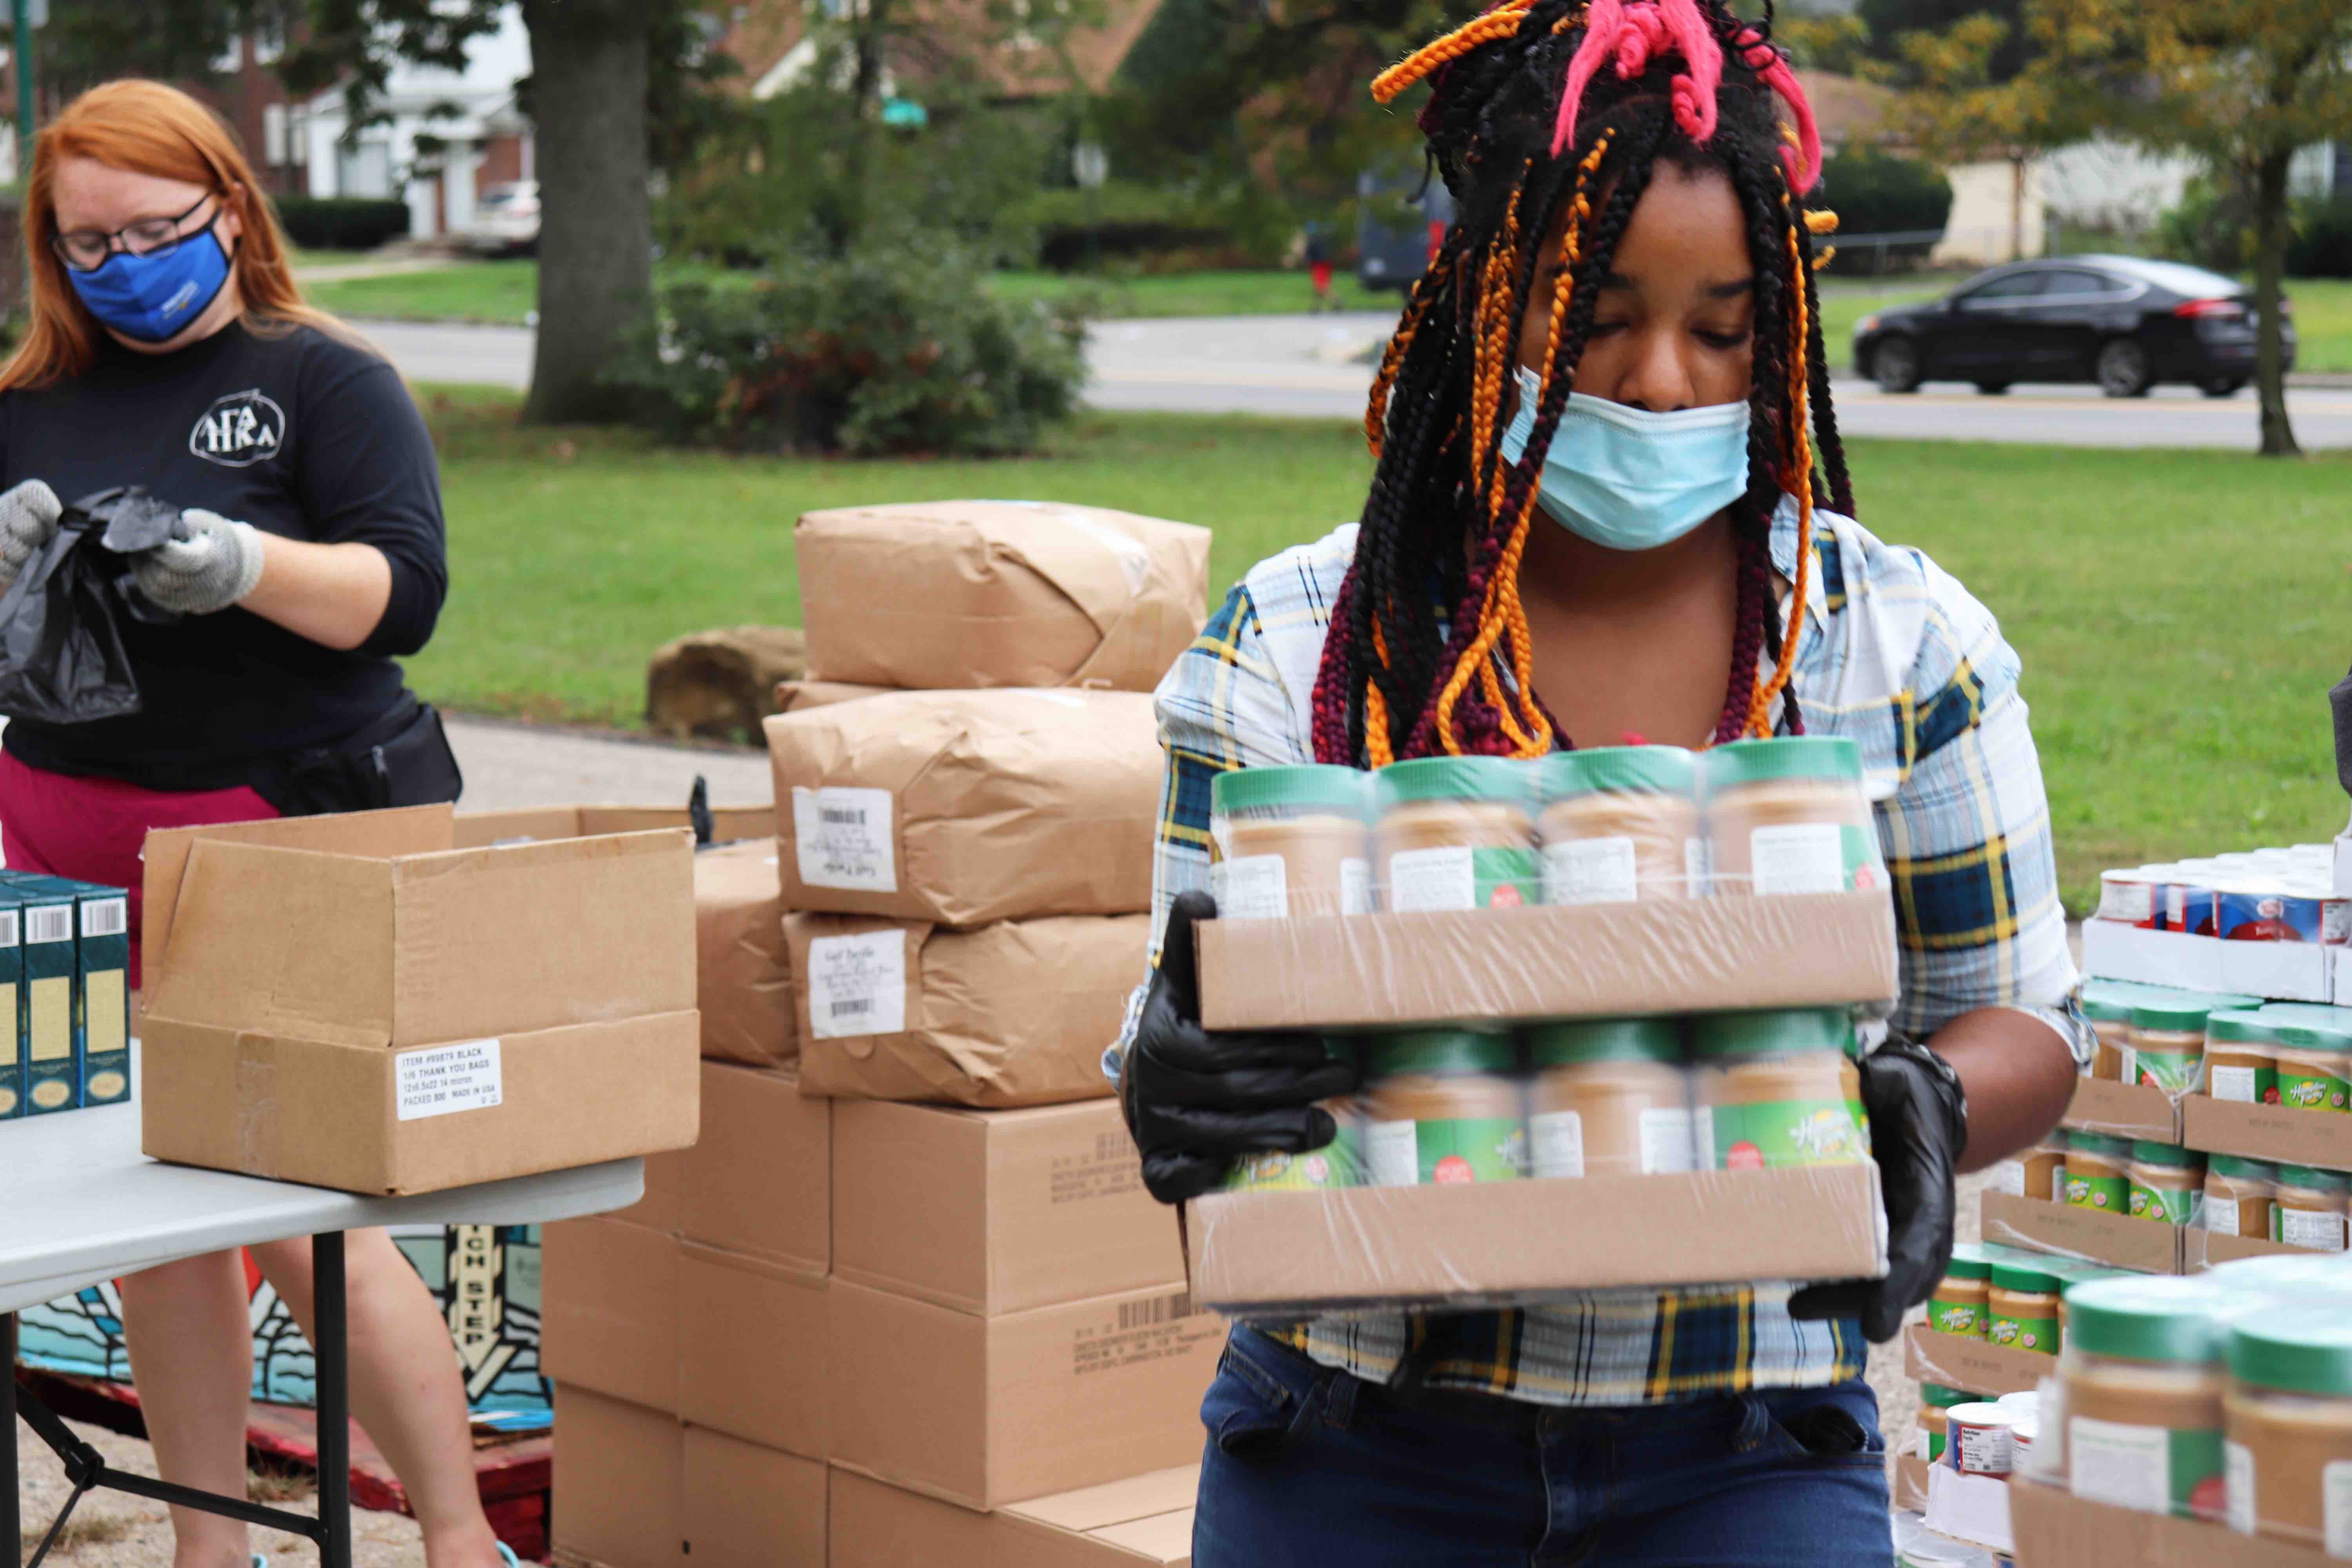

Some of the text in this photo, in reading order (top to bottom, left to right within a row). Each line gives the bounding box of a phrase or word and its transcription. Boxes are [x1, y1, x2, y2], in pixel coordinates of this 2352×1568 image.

[402, 1056, 423, 1067] ITEM
[457, 1047, 482, 1059] BLACK
[419, 1066, 446, 1078] THANK
[449, 1063, 465, 1073] YOU
[468, 1059, 490, 1070] BAGS
[404, 1094, 432, 1106] PACKED
[452, 1089, 470, 1098] MADE
[481, 1084, 495, 1093] USA
[465, 1280, 485, 1345] STEP
